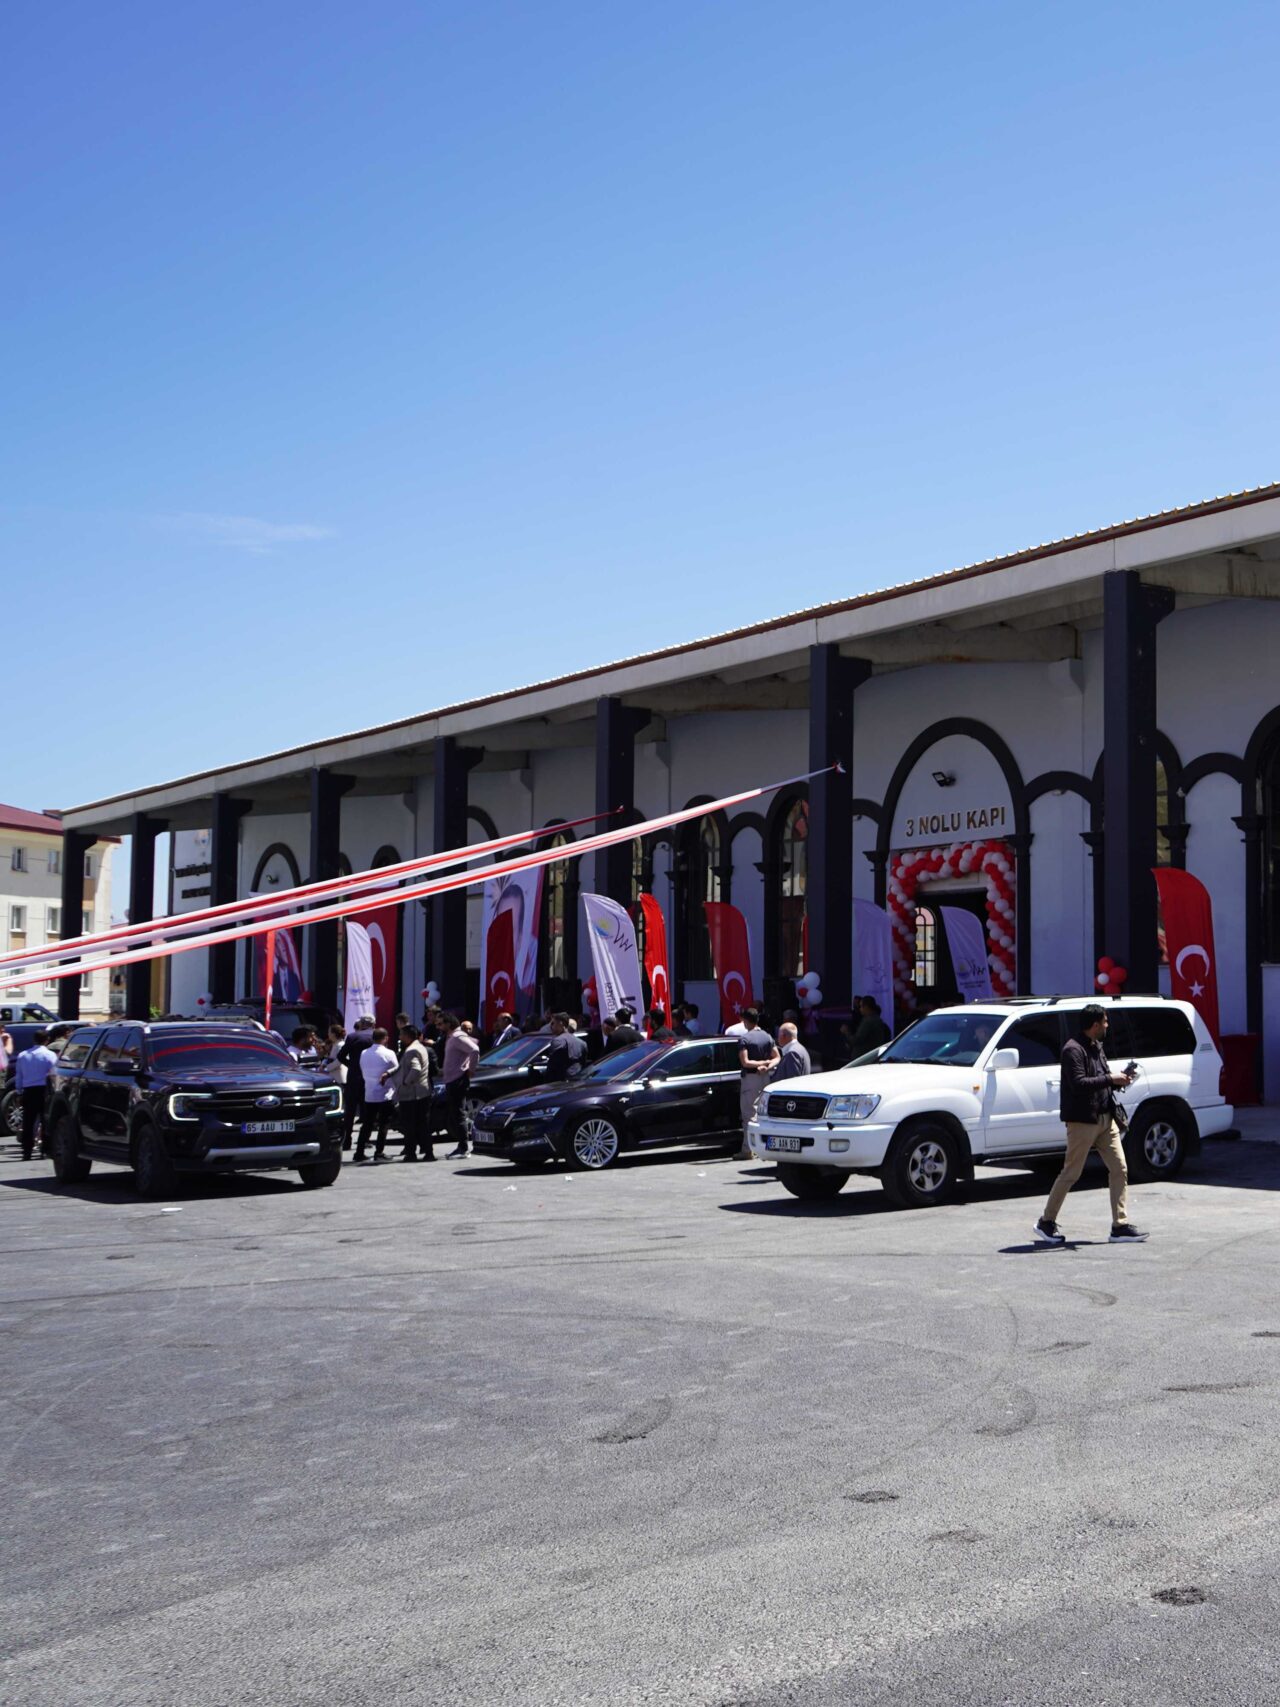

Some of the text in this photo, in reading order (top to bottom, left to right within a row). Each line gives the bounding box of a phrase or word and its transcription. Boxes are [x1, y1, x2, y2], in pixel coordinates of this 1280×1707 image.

[906, 806, 1006, 837] 3 NOLU KAPI
[246, 1123, 257, 1133] 65
[280, 1121, 294, 1131] 119
